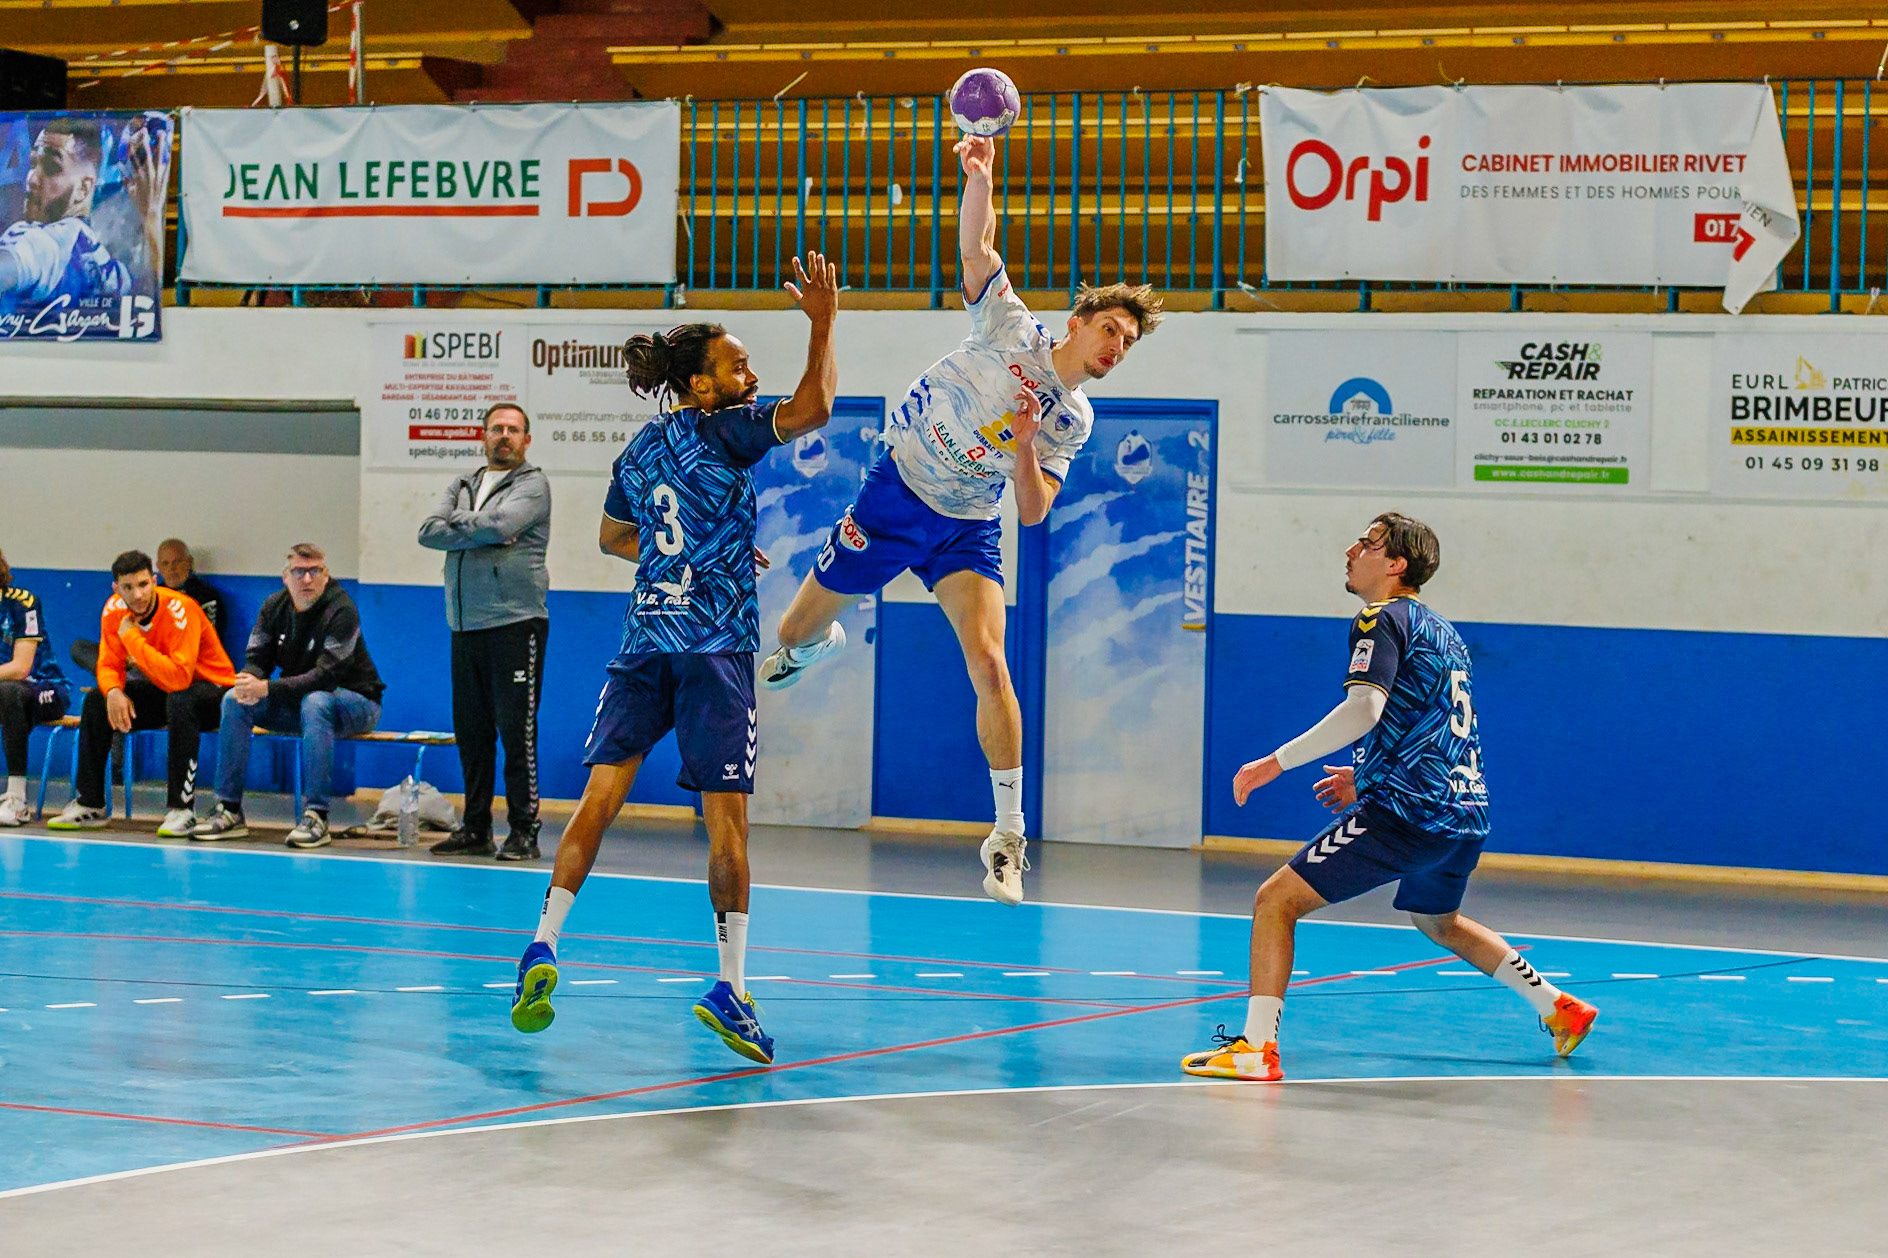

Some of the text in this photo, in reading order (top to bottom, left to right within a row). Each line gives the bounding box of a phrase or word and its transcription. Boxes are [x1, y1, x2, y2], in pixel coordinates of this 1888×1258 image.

[1462, 154, 1747, 172] CABINET IMMOBILIER RIVET
[224, 160, 541, 200] JEAN LEFEBVRE
[1287, 135, 1431, 222] Orpi
[1460, 185, 1741, 199] DES FEMMES ET DES HOMMES POUR
[0, 294, 119, 342] vry-Gargan
[1507, 362, 1601, 381] REPAIR
[1732, 374, 1888, 391] EURL PATRIC
[1473, 388, 1633, 401] REPARATION ET RACHAT
[409, 408, 422, 420] 01
[425, 408, 441, 420] 46
[445, 408, 459, 420] 70
[462, 409, 474, 420] 21
[1585, 402, 1633, 412] tablette
[537, 411, 653, 423] www.optimum-ds.co
[1273, 413, 1450, 427] carrosseriefrancilienne
[935, 421, 957, 448] JEAN
[1501, 432, 1602, 445] 01 43 01 02 78
[409, 445, 484, 458] spebi@spebi.f
[1746, 456, 1879, 472] 01 45 09 31 98
[653, 484, 684, 556] 3
[1184, 429, 1209, 621] VESTIAIRE 2
[1450, 670, 1478, 739] 5
